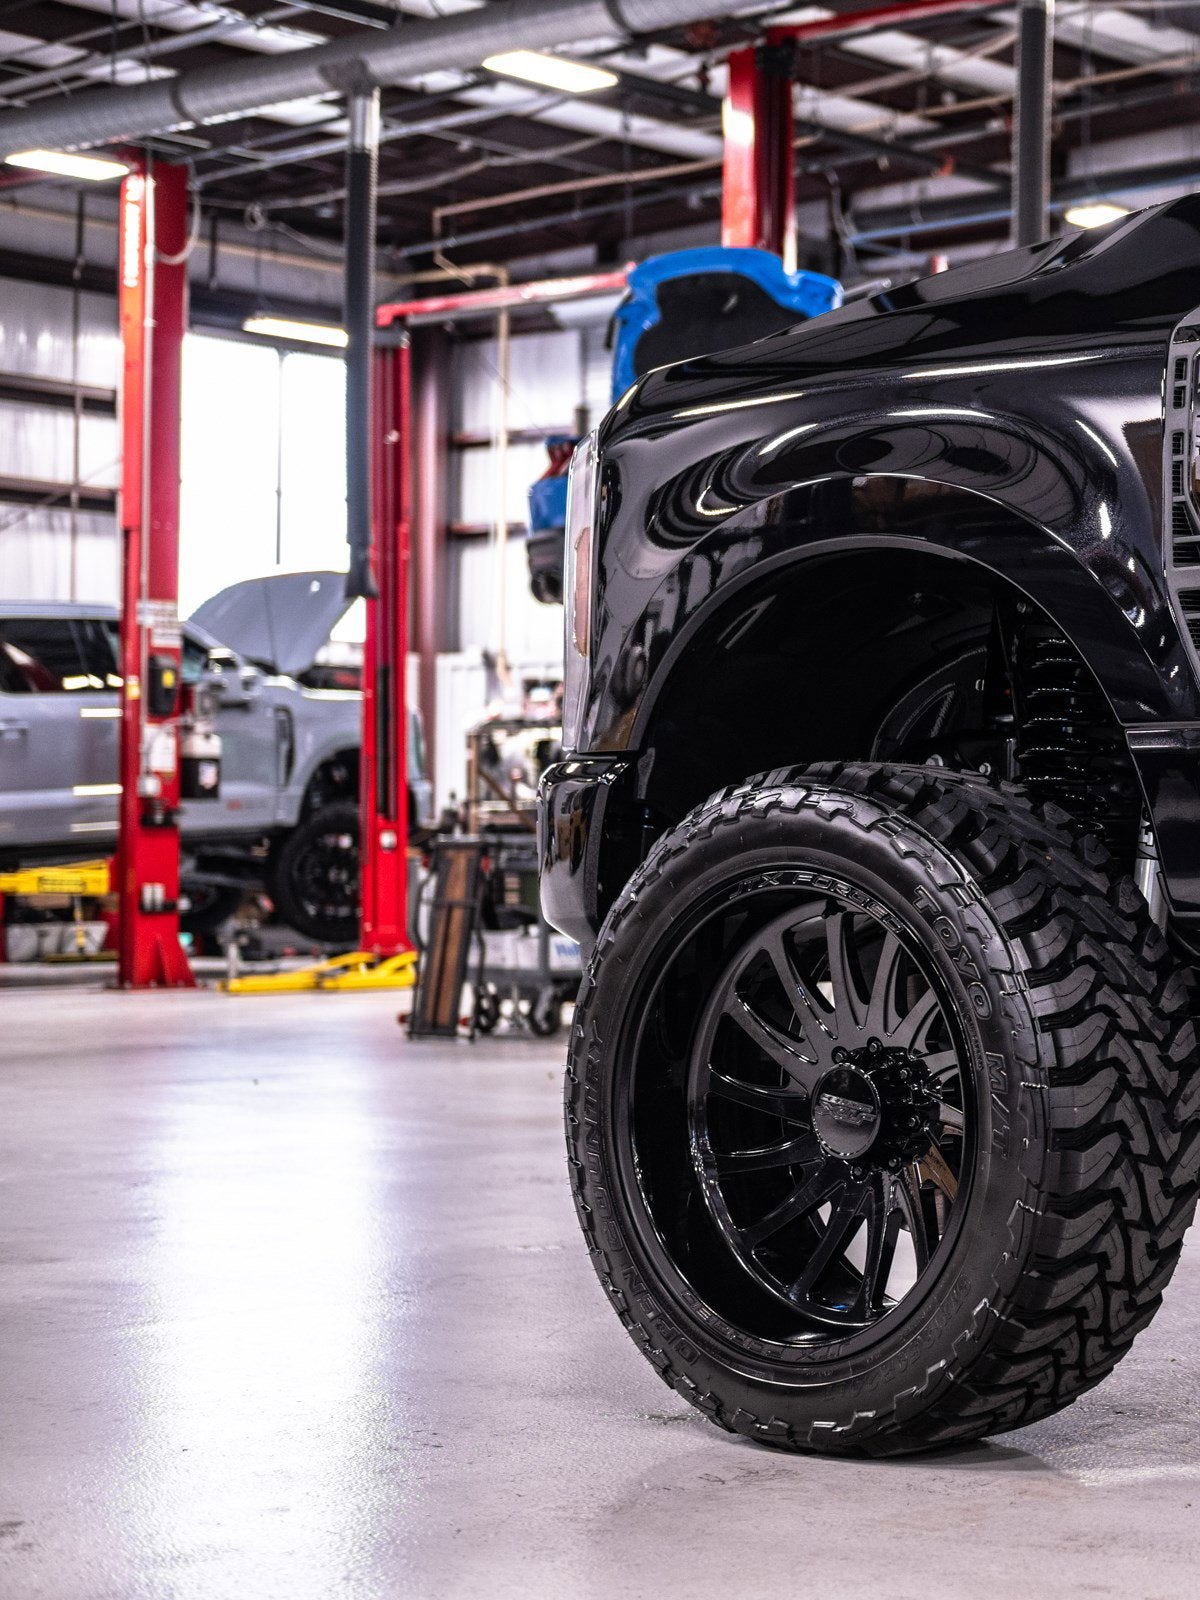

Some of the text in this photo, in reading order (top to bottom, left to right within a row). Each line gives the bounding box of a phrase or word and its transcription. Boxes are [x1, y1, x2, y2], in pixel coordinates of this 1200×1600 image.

[729, 872, 904, 934] JTX FORGED
[913, 884, 993, 1020] TOYO
[985, 1051, 1011, 1160] M/T
[584, 1019, 700, 1366] OPEN COUNTRY
